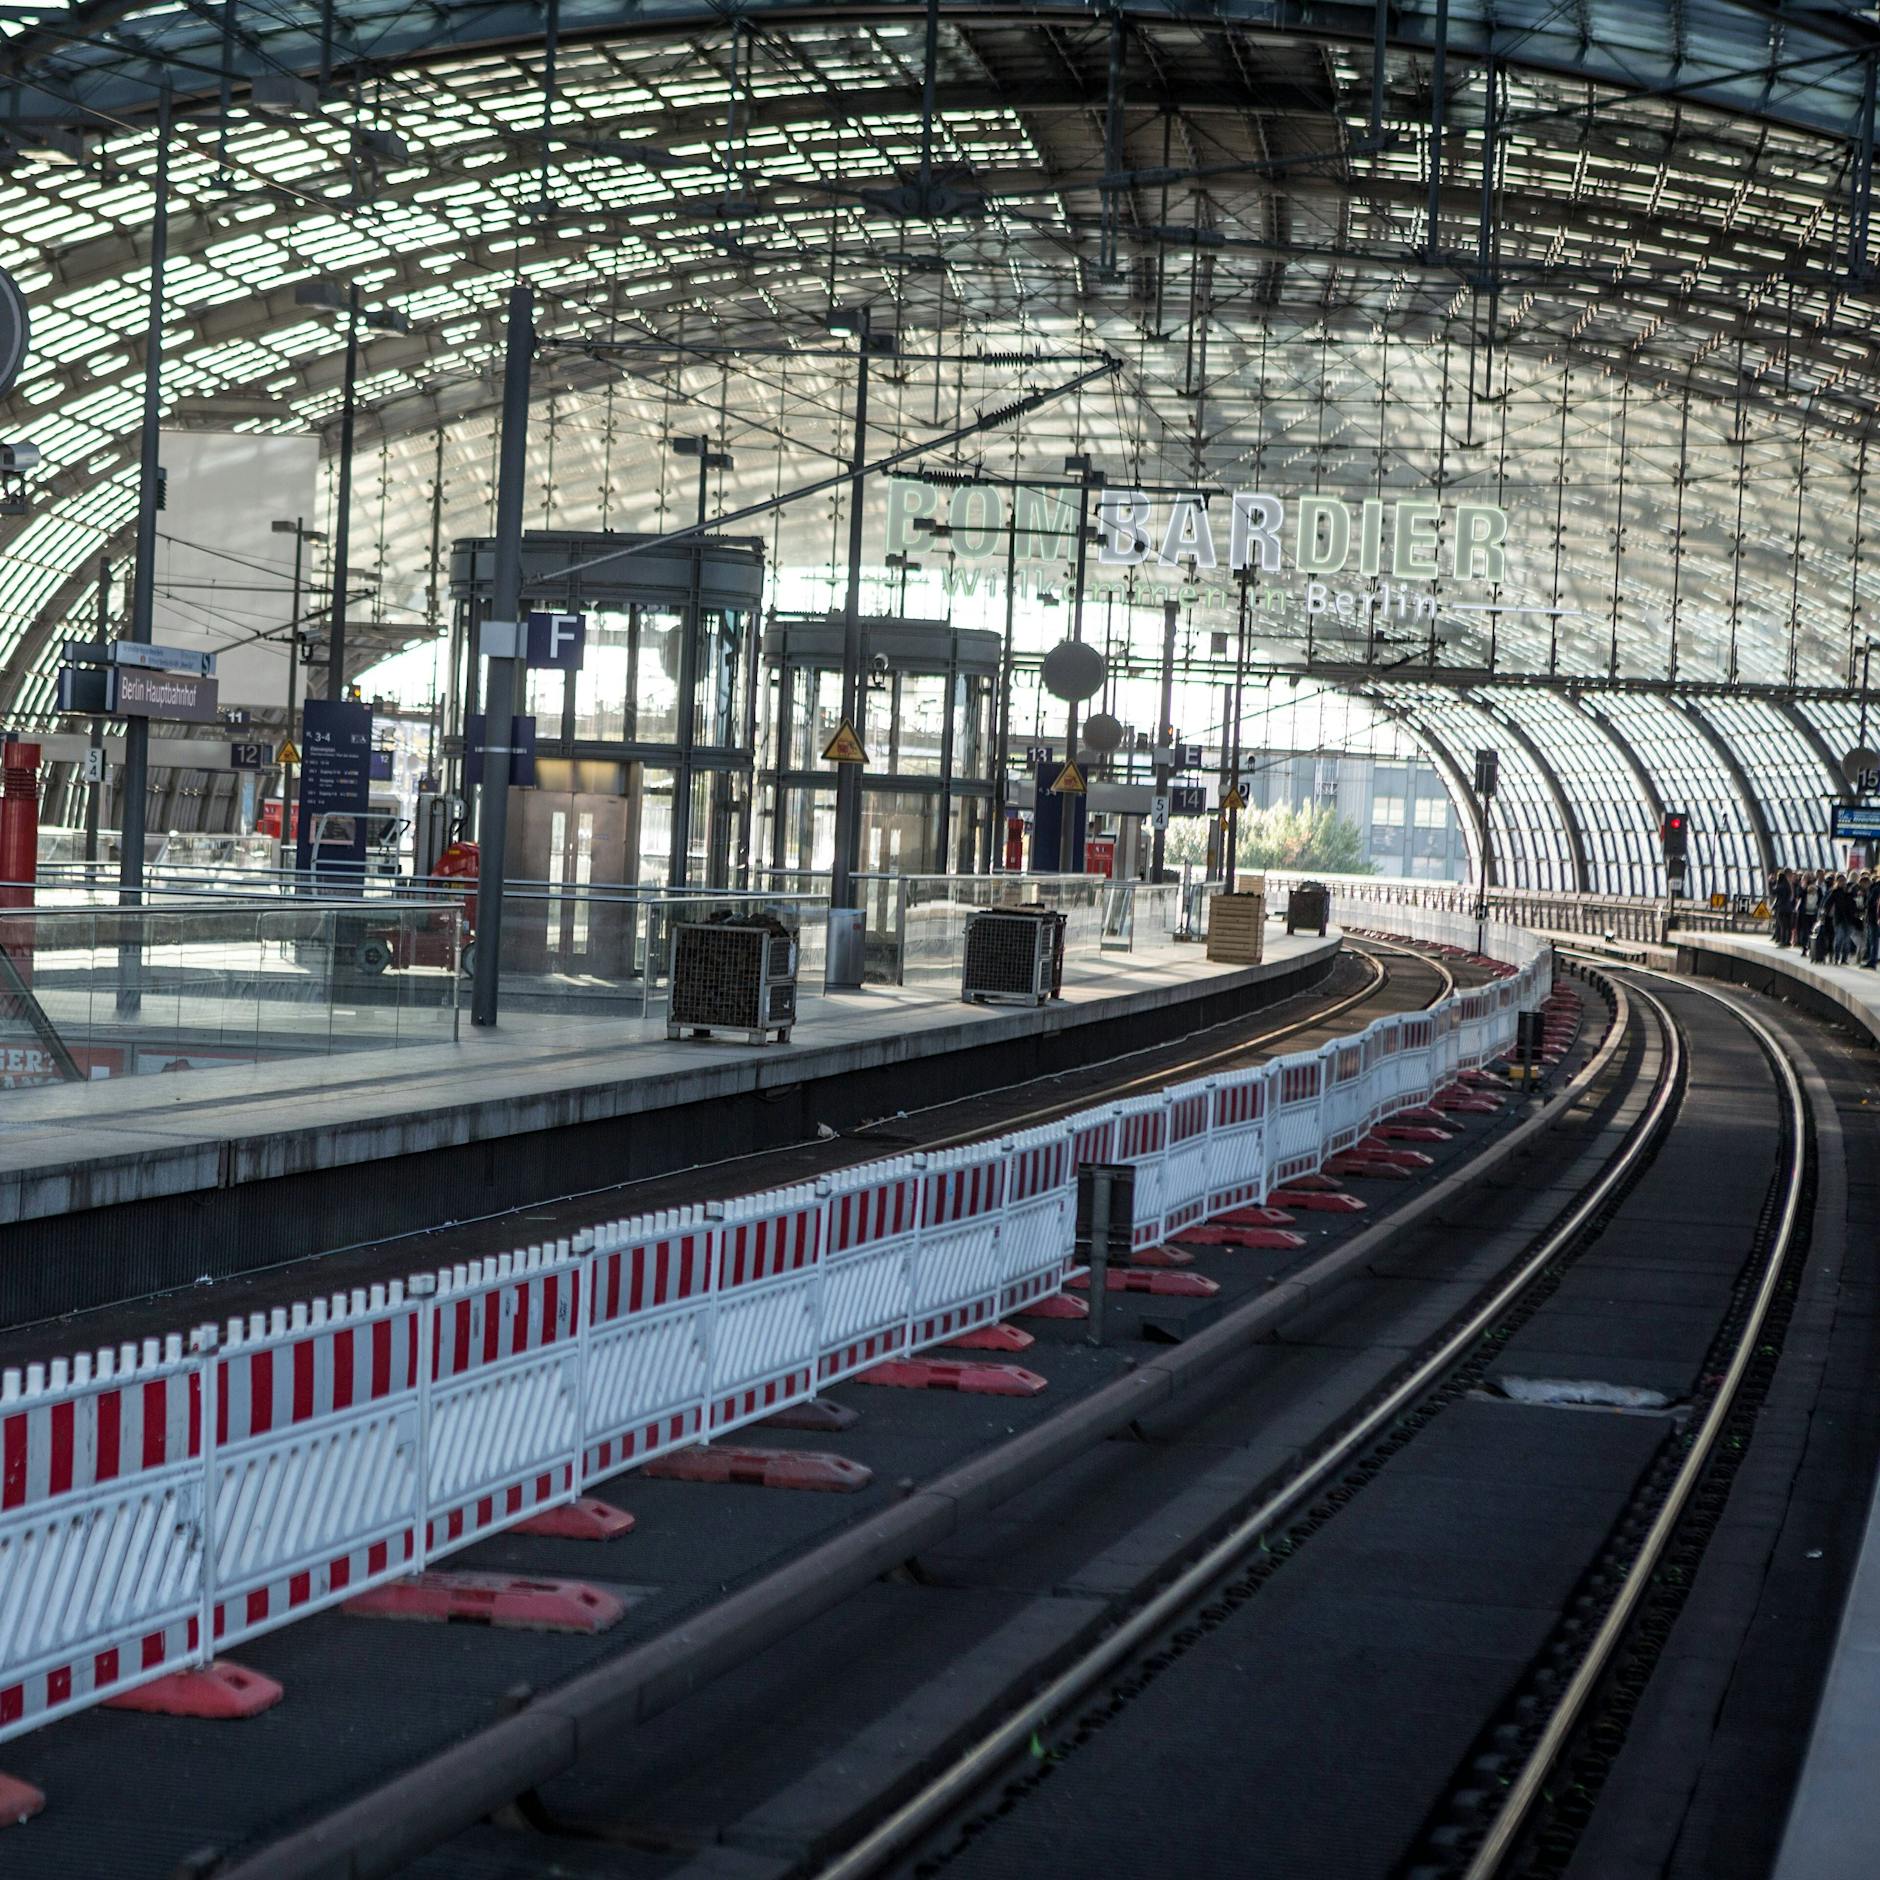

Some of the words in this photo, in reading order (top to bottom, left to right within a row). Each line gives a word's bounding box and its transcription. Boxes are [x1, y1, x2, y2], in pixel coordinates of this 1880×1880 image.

[886, 478, 1508, 583] BOMBARDIER
[1306, 580, 1438, 618] Berlin
[550, 615, 577, 658] F
[121, 676, 145, 701] Berlin
[145, 685, 198, 708] Hauptbahnhof
[227, 711, 243, 724] 11
[315, 731, 331, 743] 3-4
[89, 752, 98, 763] 5
[237, 744, 258, 764] 12
[1186, 746, 1199, 765] E
[89, 767, 97, 777] 4
[1861, 768, 1879, 788] 15
[1155, 799, 1164, 811] 5
[1179, 790, 1200, 809] 14
[1156, 813, 1164, 825] 4
